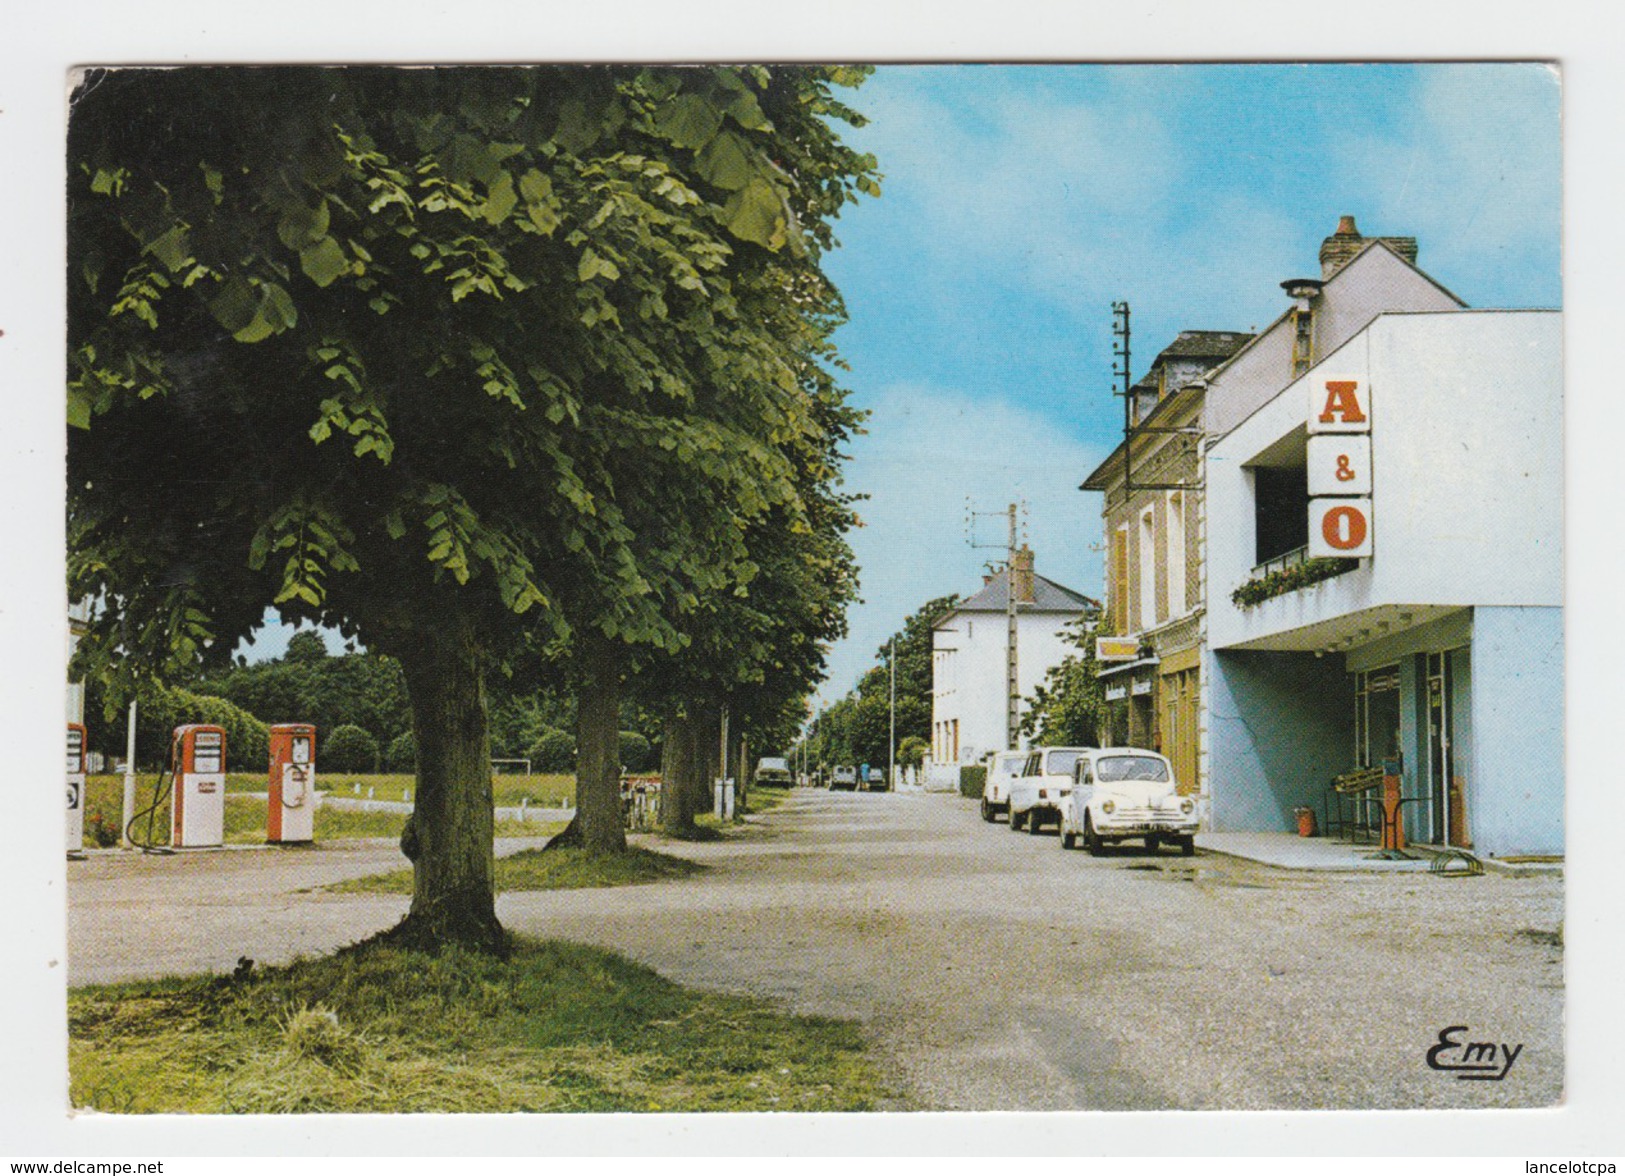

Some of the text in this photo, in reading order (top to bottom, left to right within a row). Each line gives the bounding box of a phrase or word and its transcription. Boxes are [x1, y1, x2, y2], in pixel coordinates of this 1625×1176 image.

[1319, 380, 1367, 550] A & O
